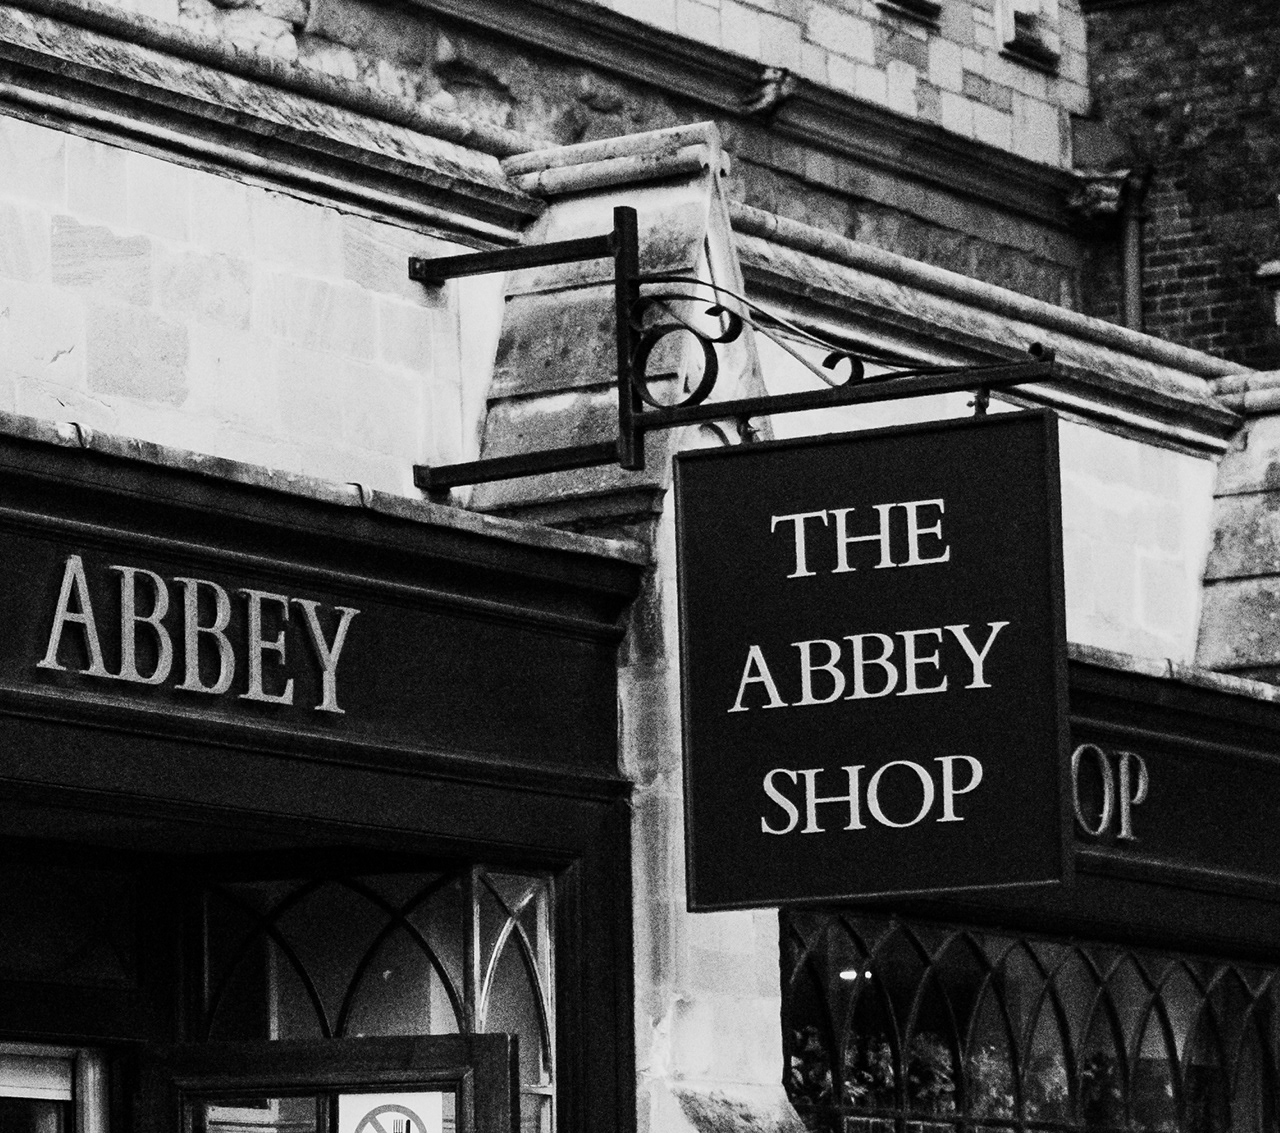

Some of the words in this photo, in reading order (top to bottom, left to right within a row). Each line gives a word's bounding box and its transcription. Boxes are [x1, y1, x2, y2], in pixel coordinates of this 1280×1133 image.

[770, 498, 950, 578] THE
[36, 553, 361, 714] ABBEY
[727, 621, 1010, 713] ABBEY
[760, 755, 983, 835] SHOP
[1071, 743, 1149, 840] OP
